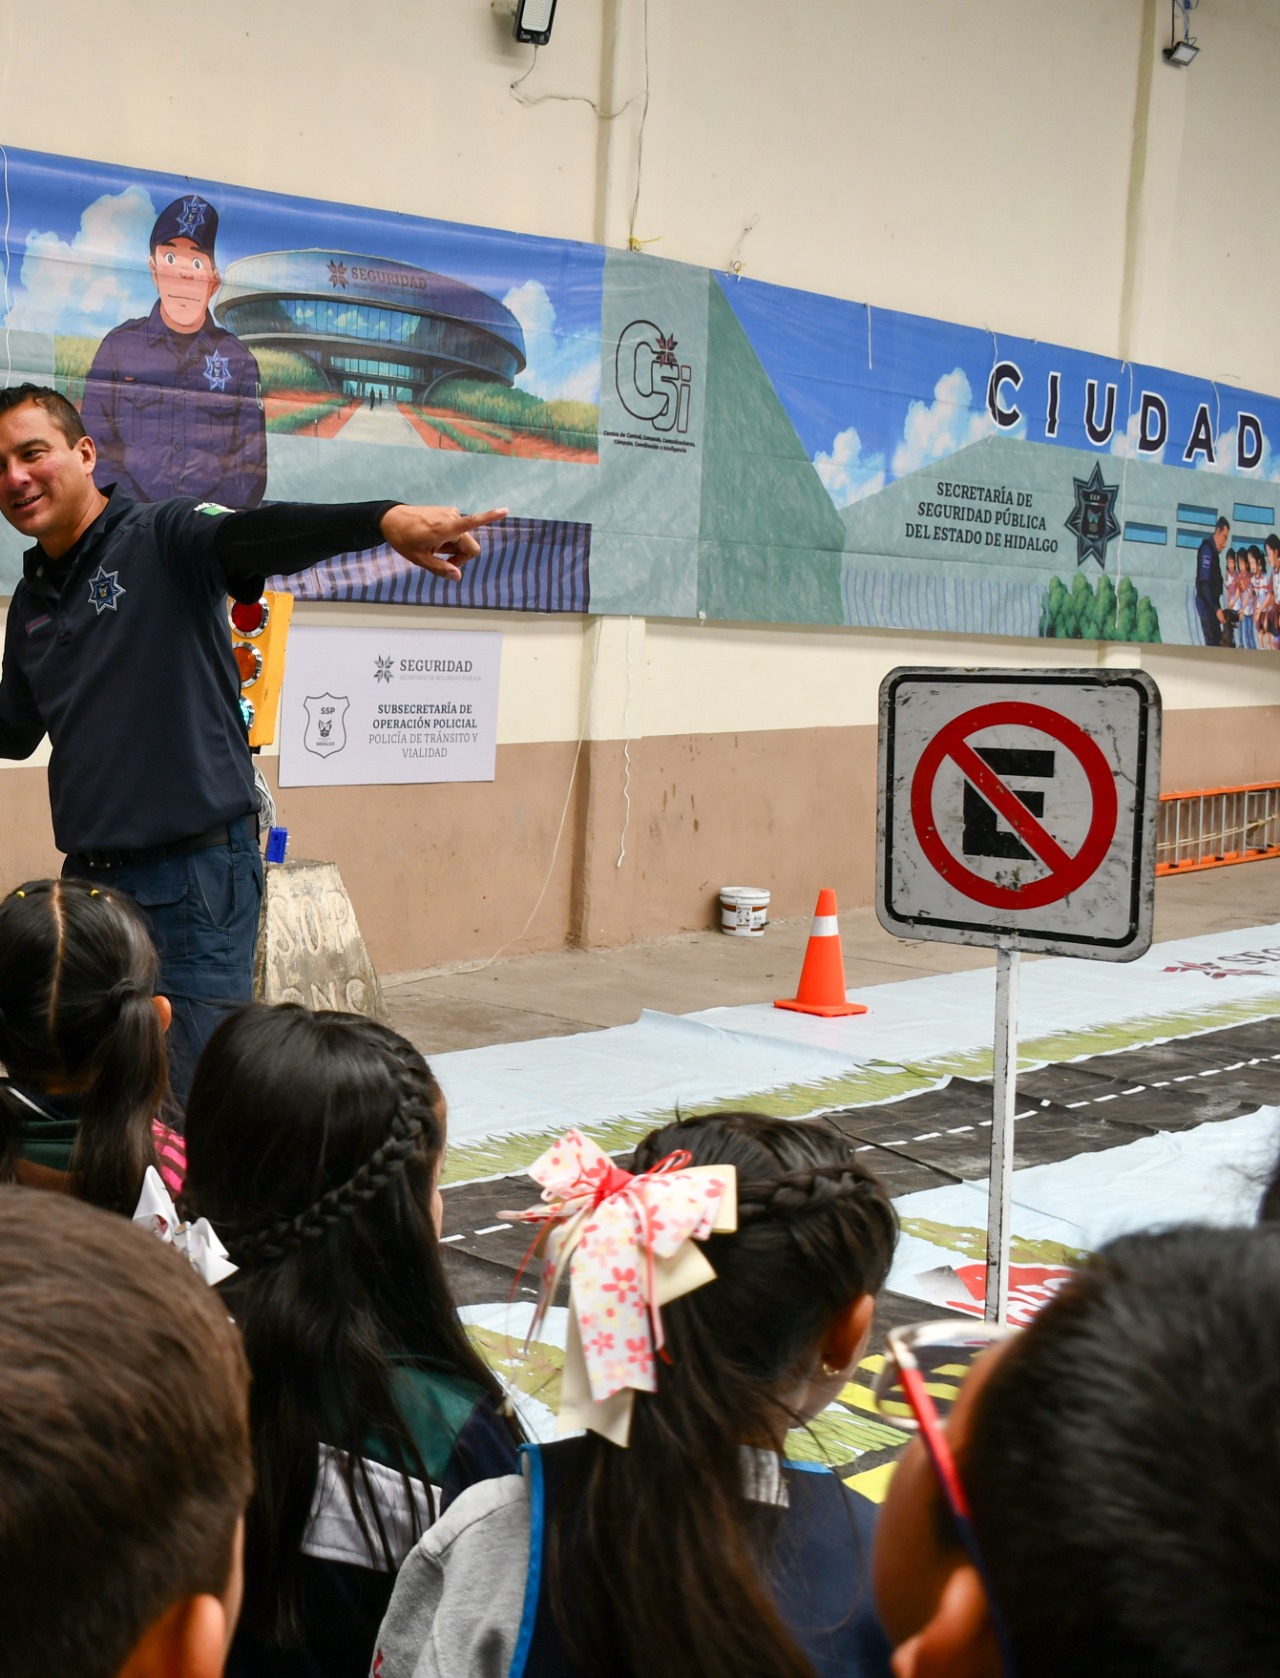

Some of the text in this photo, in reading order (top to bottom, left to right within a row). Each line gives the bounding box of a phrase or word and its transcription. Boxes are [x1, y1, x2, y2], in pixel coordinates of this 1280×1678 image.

[351, 267, 427, 289] SEGURIDAD
[986, 361, 1263, 471] CIUDAD
[936, 482, 1033, 507] SECRETARÍA DE
[917, 501, 1047, 531] SEGURIDAD PÚBLICA
[905, 523, 1058, 553] DEL ESTADO DE HIDALGO
[400, 659, 473, 672] SEGURIDAD
[320, 706, 335, 714] SSP
[377, 701, 472, 714] SUBSECRETARÍA DE
[372, 716, 477, 729] OPERACIÓN POLICIAL
[368, 730, 478, 744] POLICÍA DE TRÁNSITO Y
[402, 747, 448, 758] VIALIDAD
